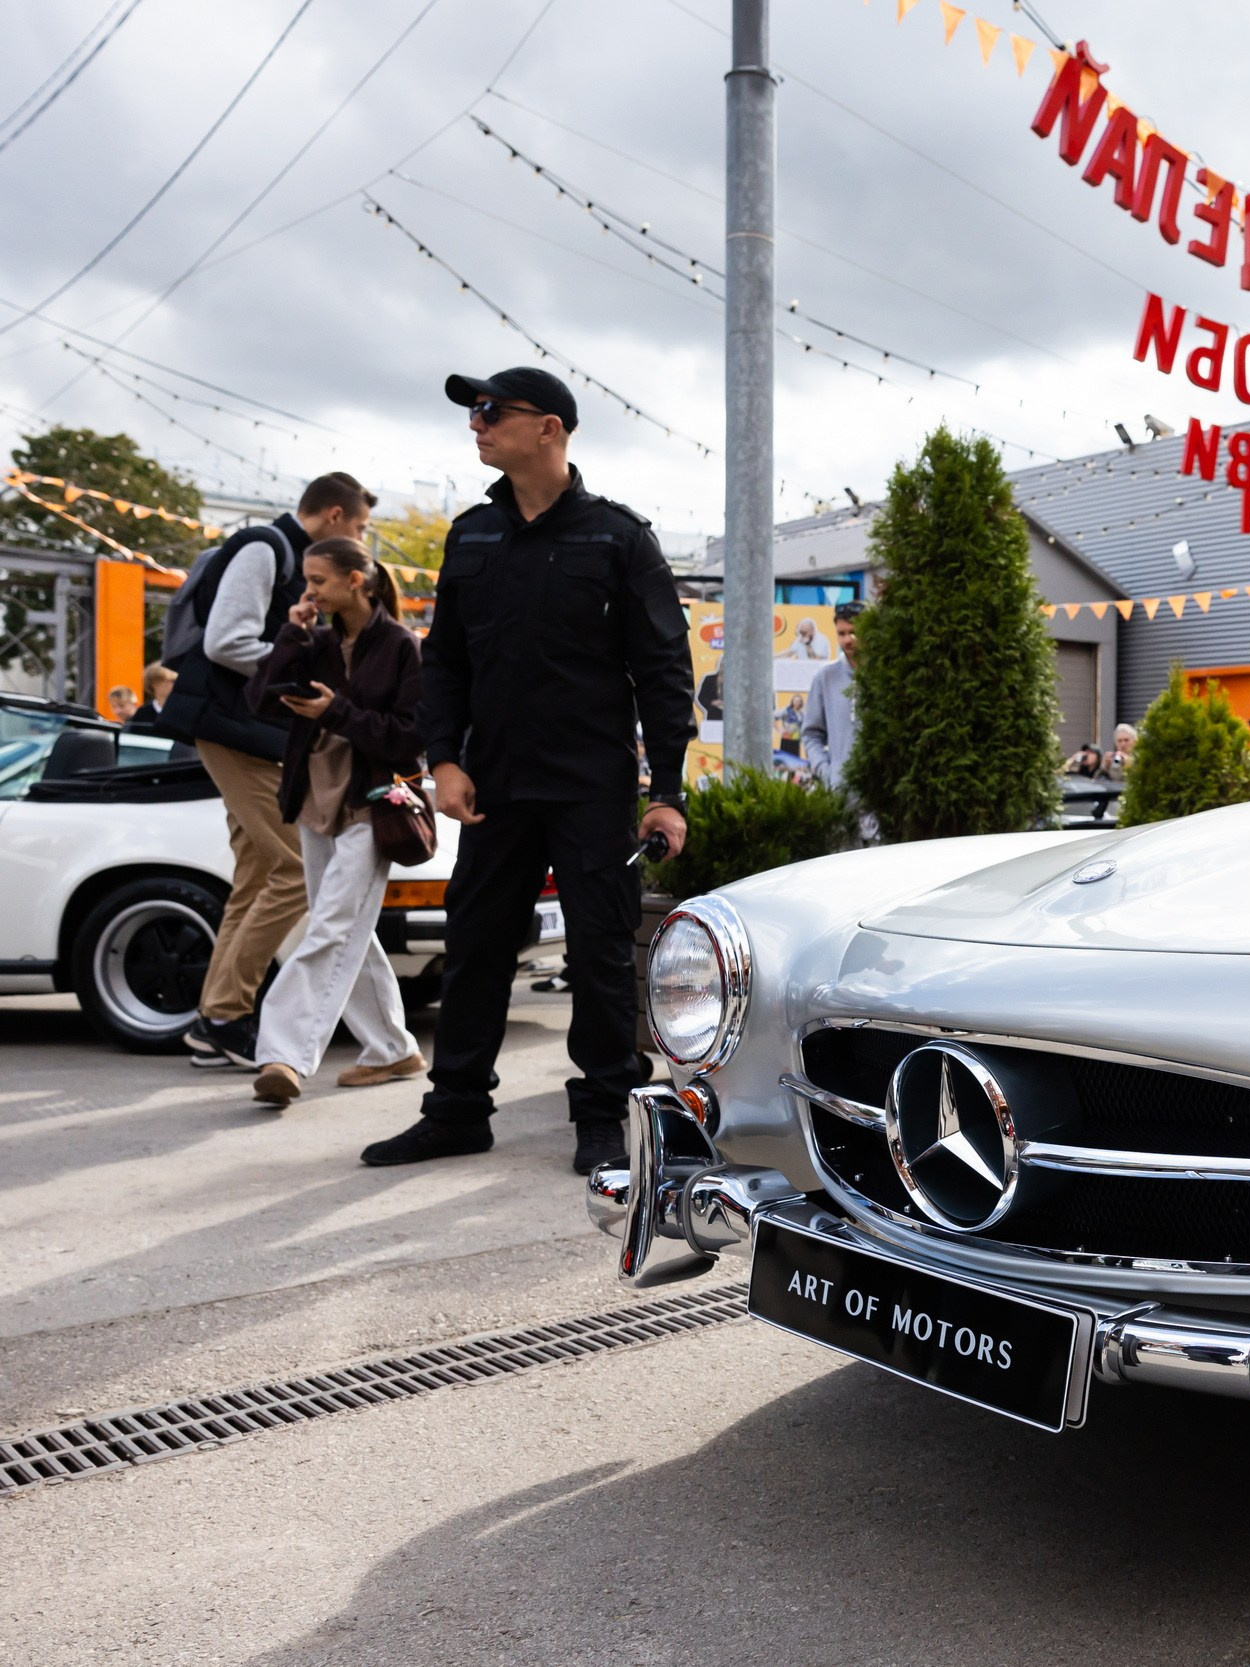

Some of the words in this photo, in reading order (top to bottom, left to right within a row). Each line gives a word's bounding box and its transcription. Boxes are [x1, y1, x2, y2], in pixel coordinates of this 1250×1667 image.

[788, 1270, 834, 1306] ART
[845, 1289, 880, 1320] OF
[892, 1304, 1013, 1370] MOTORS
